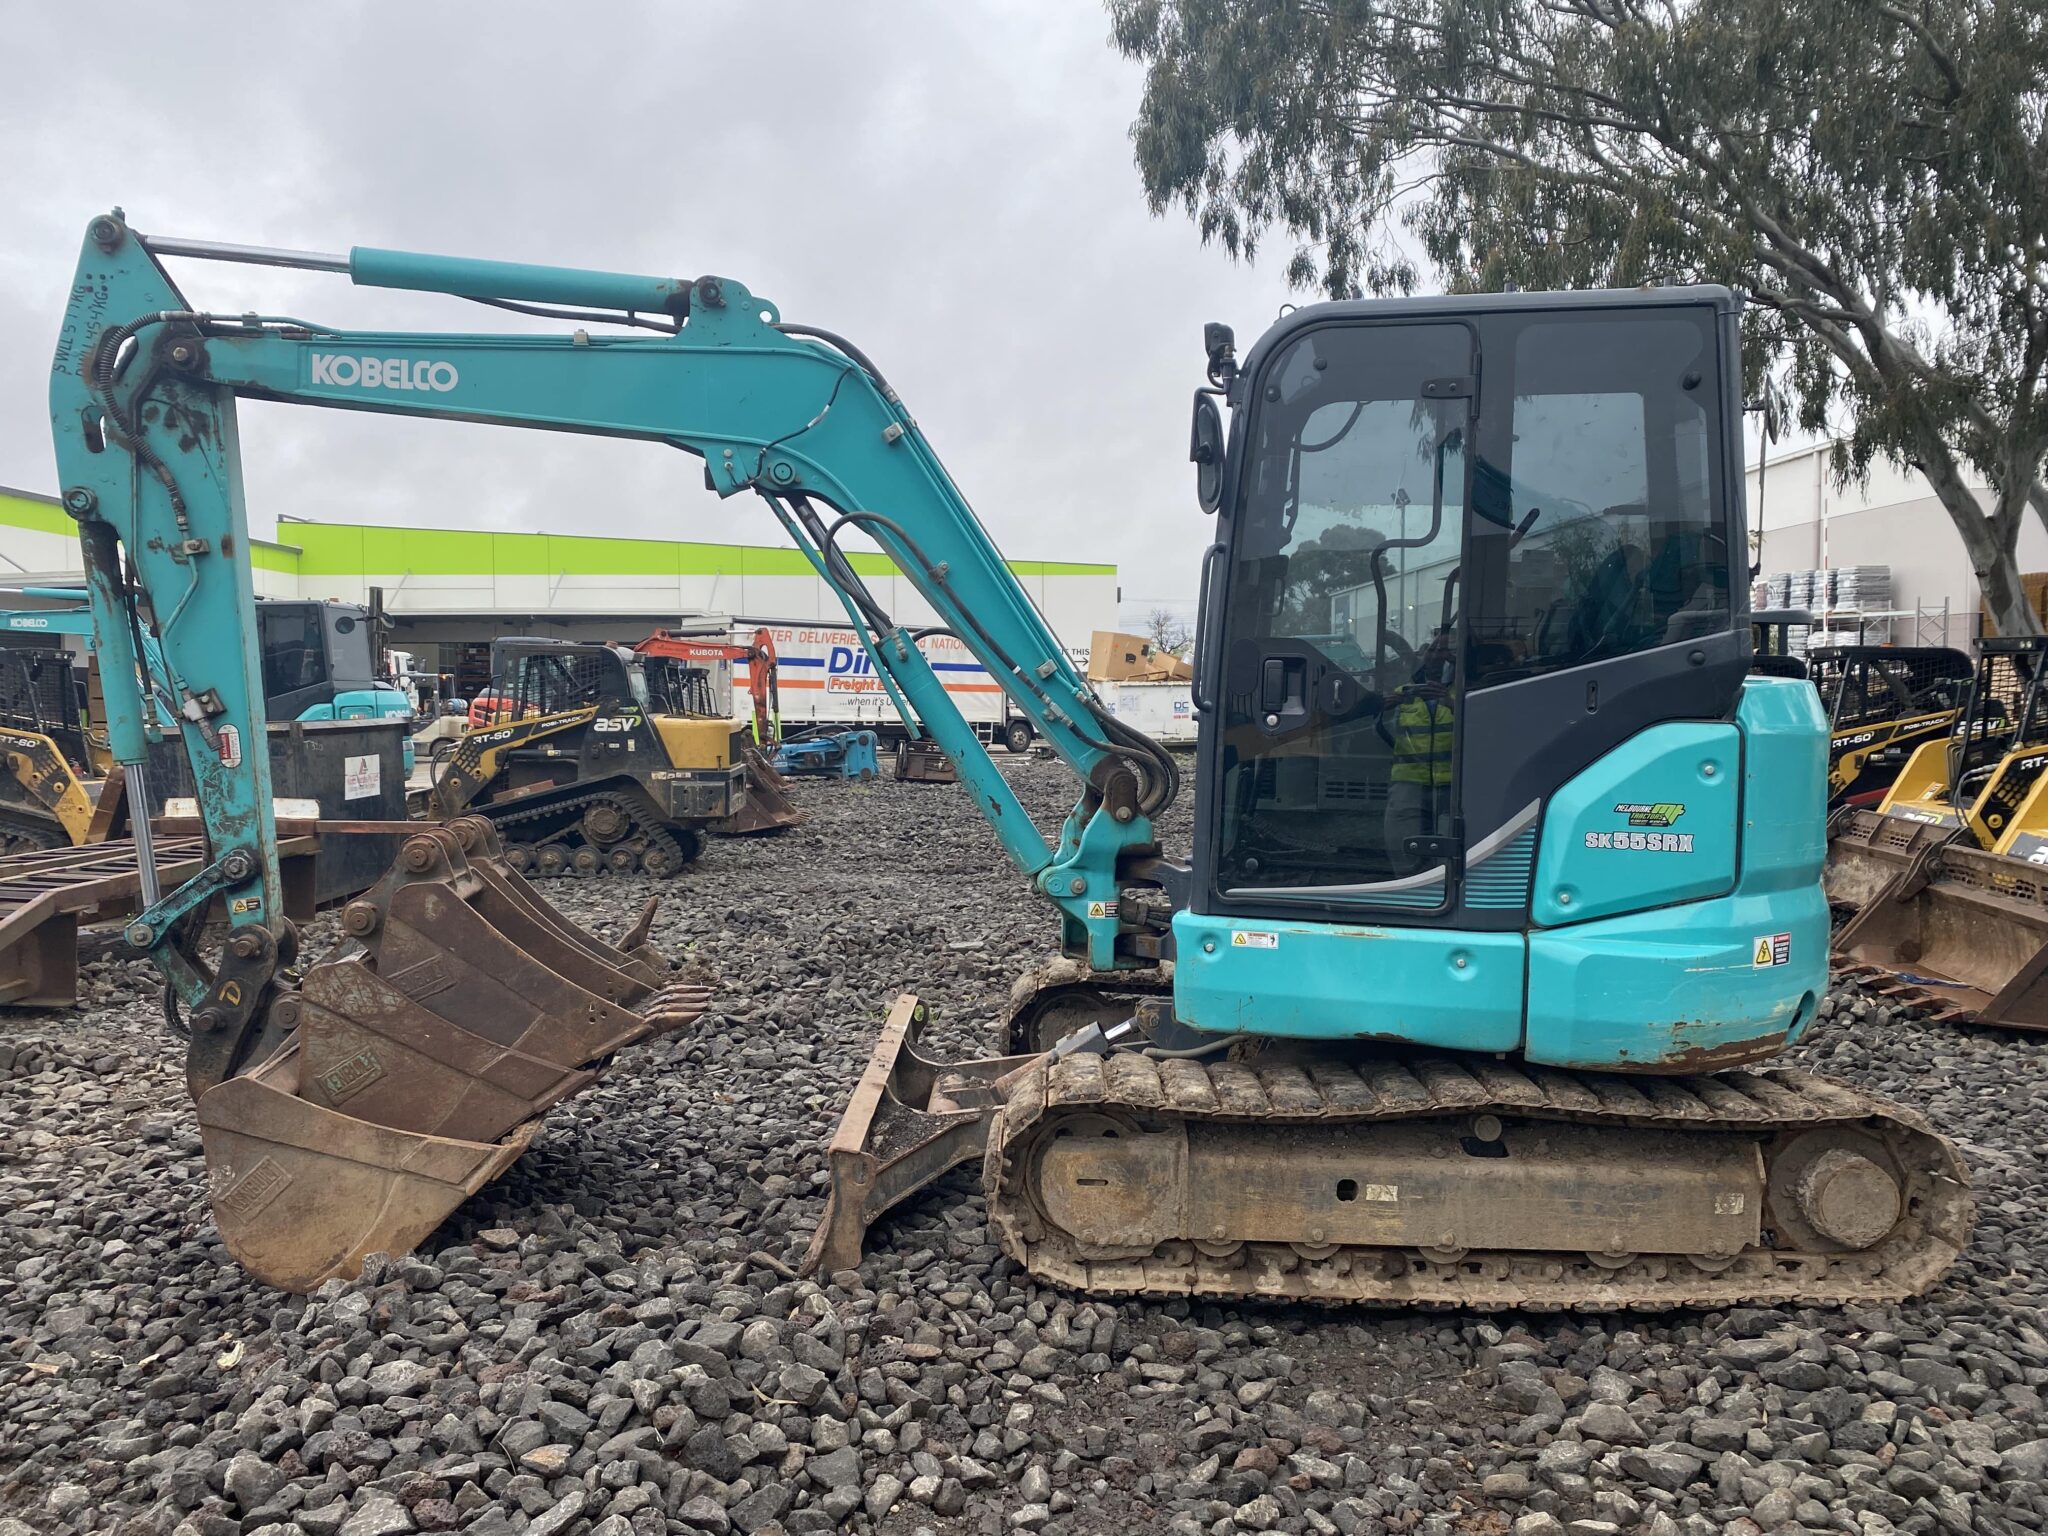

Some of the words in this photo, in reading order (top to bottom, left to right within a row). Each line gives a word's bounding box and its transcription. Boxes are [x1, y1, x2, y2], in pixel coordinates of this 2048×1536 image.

[311, 353, 459, 392] KOBELCO
[798, 630, 862, 646] DELIVERIE
[689, 648, 724, 657] KUBOTA
[1071, 648, 1090, 656] THIS
[830, 677, 876, 693] Freight
[473, 732, 512, 745] RT-60
[1832, 733, 1872, 748] RT-60
[1584, 831, 1695, 853] SK55SRX
